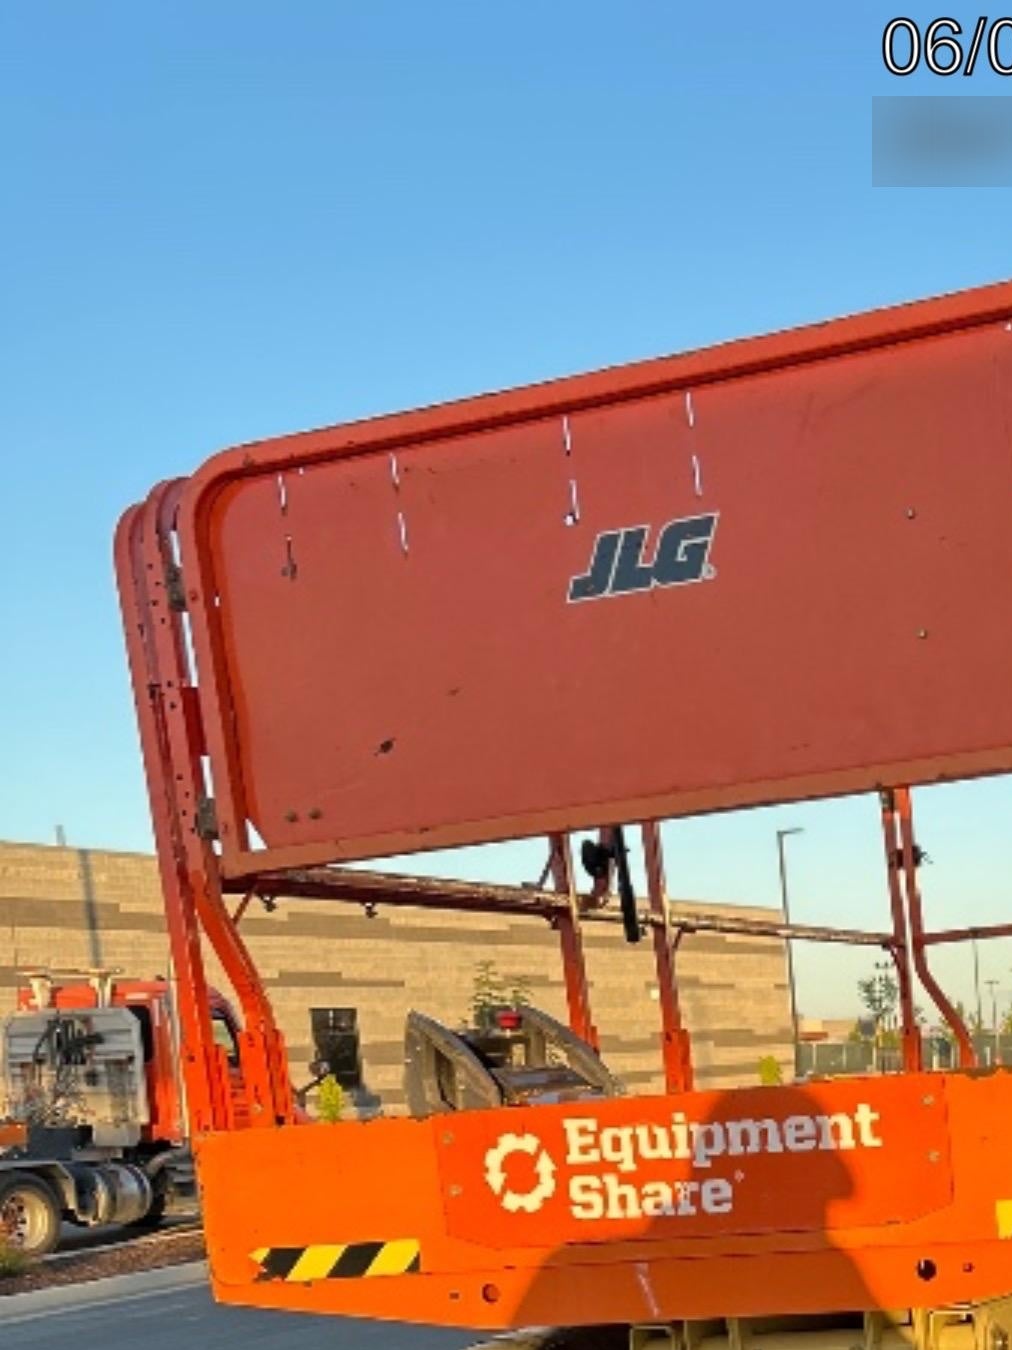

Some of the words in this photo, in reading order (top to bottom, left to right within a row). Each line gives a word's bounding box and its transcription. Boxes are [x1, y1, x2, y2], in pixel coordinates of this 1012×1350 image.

[566, 510, 720, 604] JLG
[562, 1102, 883, 1171] Equipment
[568, 1174, 734, 1220] Share
